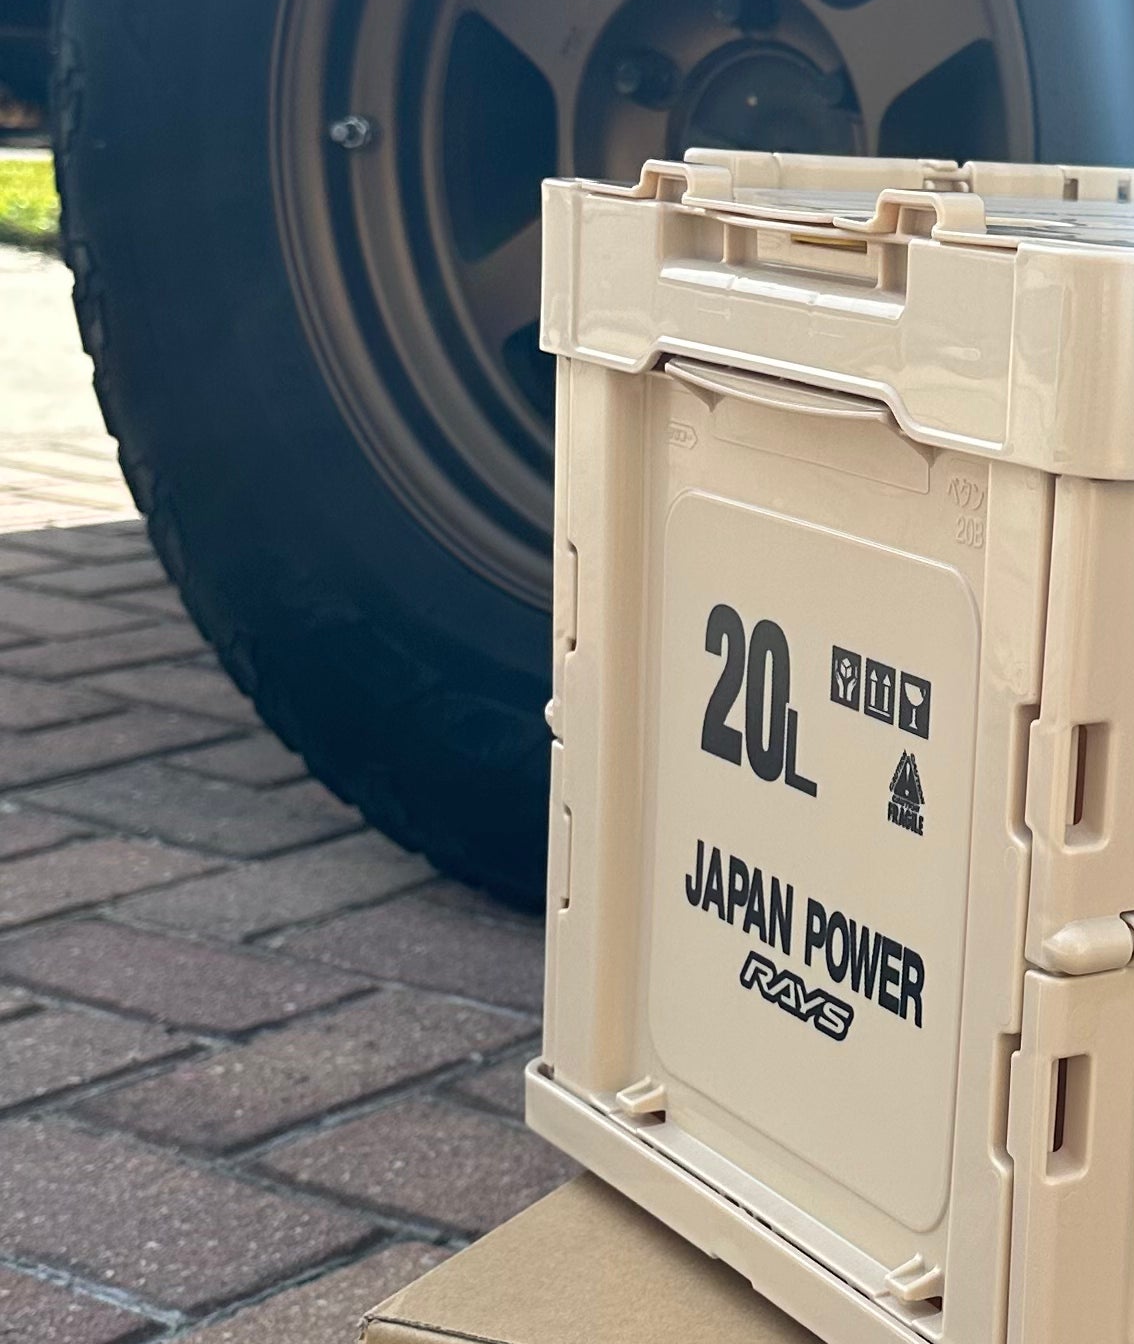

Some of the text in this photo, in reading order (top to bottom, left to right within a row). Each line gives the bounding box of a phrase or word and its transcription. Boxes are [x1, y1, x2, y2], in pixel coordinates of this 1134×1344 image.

[701, 604, 818, 797] 20L
[685, 839, 925, 1029] JAPAN POWER
[740, 950, 853, 1042] RAYS
